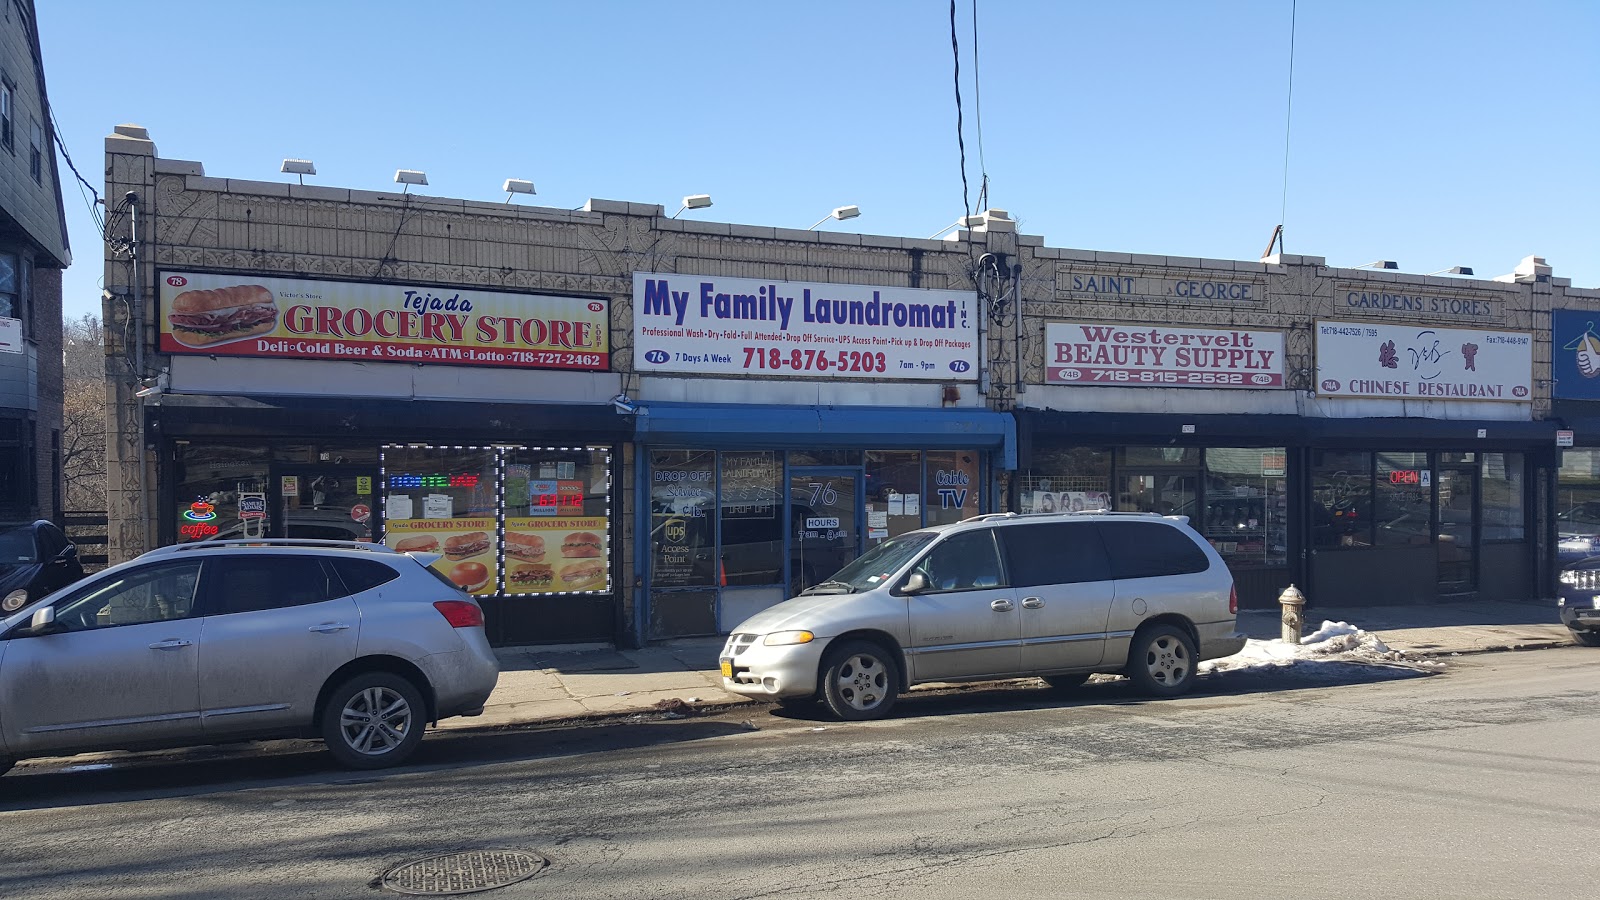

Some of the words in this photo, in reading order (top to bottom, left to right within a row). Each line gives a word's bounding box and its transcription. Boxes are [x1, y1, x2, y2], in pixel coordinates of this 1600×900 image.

[170, 277, 182, 286] 78
[1073, 275, 1135, 294] SAINT
[1176, 281, 1252, 300] GEORGE
[280, 292, 304, 300] Victor's
[403, 290, 473, 316] Tejada
[591, 303, 600, 311] 78
[643, 279, 690, 326] My
[700, 283, 794, 330] Family
[803, 288, 956, 329] Laundromat
[1347, 291, 1423, 312] GARDENS
[1431, 298, 1491, 316] STORES
[960, 300, 971, 329] INC.
[283, 305, 470, 343] GROCERY
[476, 315, 593, 349] STORE
[642, 326, 684, 338] Professional
[686, 328, 704, 338] Wash
[708, 329, 720, 341] Dry
[723, 330, 737, 340] Fold
[741, 331, 753, 341] Full
[754, 332, 783, 342] Attended
[786, 333, 801, 344] Drop
[803, 333, 813, 343] Off
[814, 334, 835, 344] Service
[838, 335, 851, 344] UPS
[852, 336, 871, 345] Access
[873, 336, 888, 346] Point
[891, 337, 904, 346] Pick
[904, 340, 913, 348] up
[920, 339, 933, 349] Drop
[935, 339, 944, 348] Off
[945, 340, 971, 350] Packages
[1080, 325, 1254, 348] Westervelt
[257, 340, 288, 353] Deli
[297, 342, 329, 354] Cold
[335, 343, 368, 356] Beer
[371, 345, 383, 357] &
[387, 345, 423, 358] Soda
[431, 348, 461, 360] ATM
[469, 349, 504, 362] Lotto
[512, 351, 600, 366] 718-727-2462
[651, 351, 664, 363] 76
[675, 352, 680, 361] 7
[683, 352, 701, 365] Days
[703, 353, 709, 362] A
[711, 354, 732, 363] Week
[743, 347, 887, 373] 718-876-5203
[1054, 342, 1167, 367] BEAUTY
[1175, 349, 1275, 370] SUPPLY
[899, 360, 914, 369] 7am
[921, 361, 936, 371] 9pm
[954, 361, 965, 371] 76
[1062, 370, 1079, 378] 74B
[1090, 369, 1243, 384] 718-815-2532
[1254, 375, 1270, 383] 74B
[1349, 380, 1410, 395] CHINESE
[1418, 382, 1503, 397] RESTAURANT
[320, 452, 330, 461] 78
[726, 457, 739, 467] MY
[740, 456, 770, 466] FAMILY
[654, 470, 688, 482] DROP
[690, 470, 712, 482] OFF
[935, 469, 970, 486] Cable
[1390, 471, 1419, 483] OPEN
[1422, 473, 1429, 482] A
[666, 483, 702, 498] Service
[808, 481, 838, 507] 76
[539, 493, 557, 507] 63
[562, 493, 583, 507] 112
[937, 488, 968, 510] TV
[410, 521, 454, 529] GROCERY
[456, 520, 487, 528] STORE
[527, 521, 568, 529] GROCERY
[570, 520, 598, 528] STORE
[808, 519, 838, 527] HOURS
[181, 522, 219, 539] coffee
[667, 526, 684, 540] ups
[798, 530, 819, 541] 7am
[826, 529, 848, 541] 9pm
[661, 544, 690, 553] Access
[663, 554, 686, 563] Point
